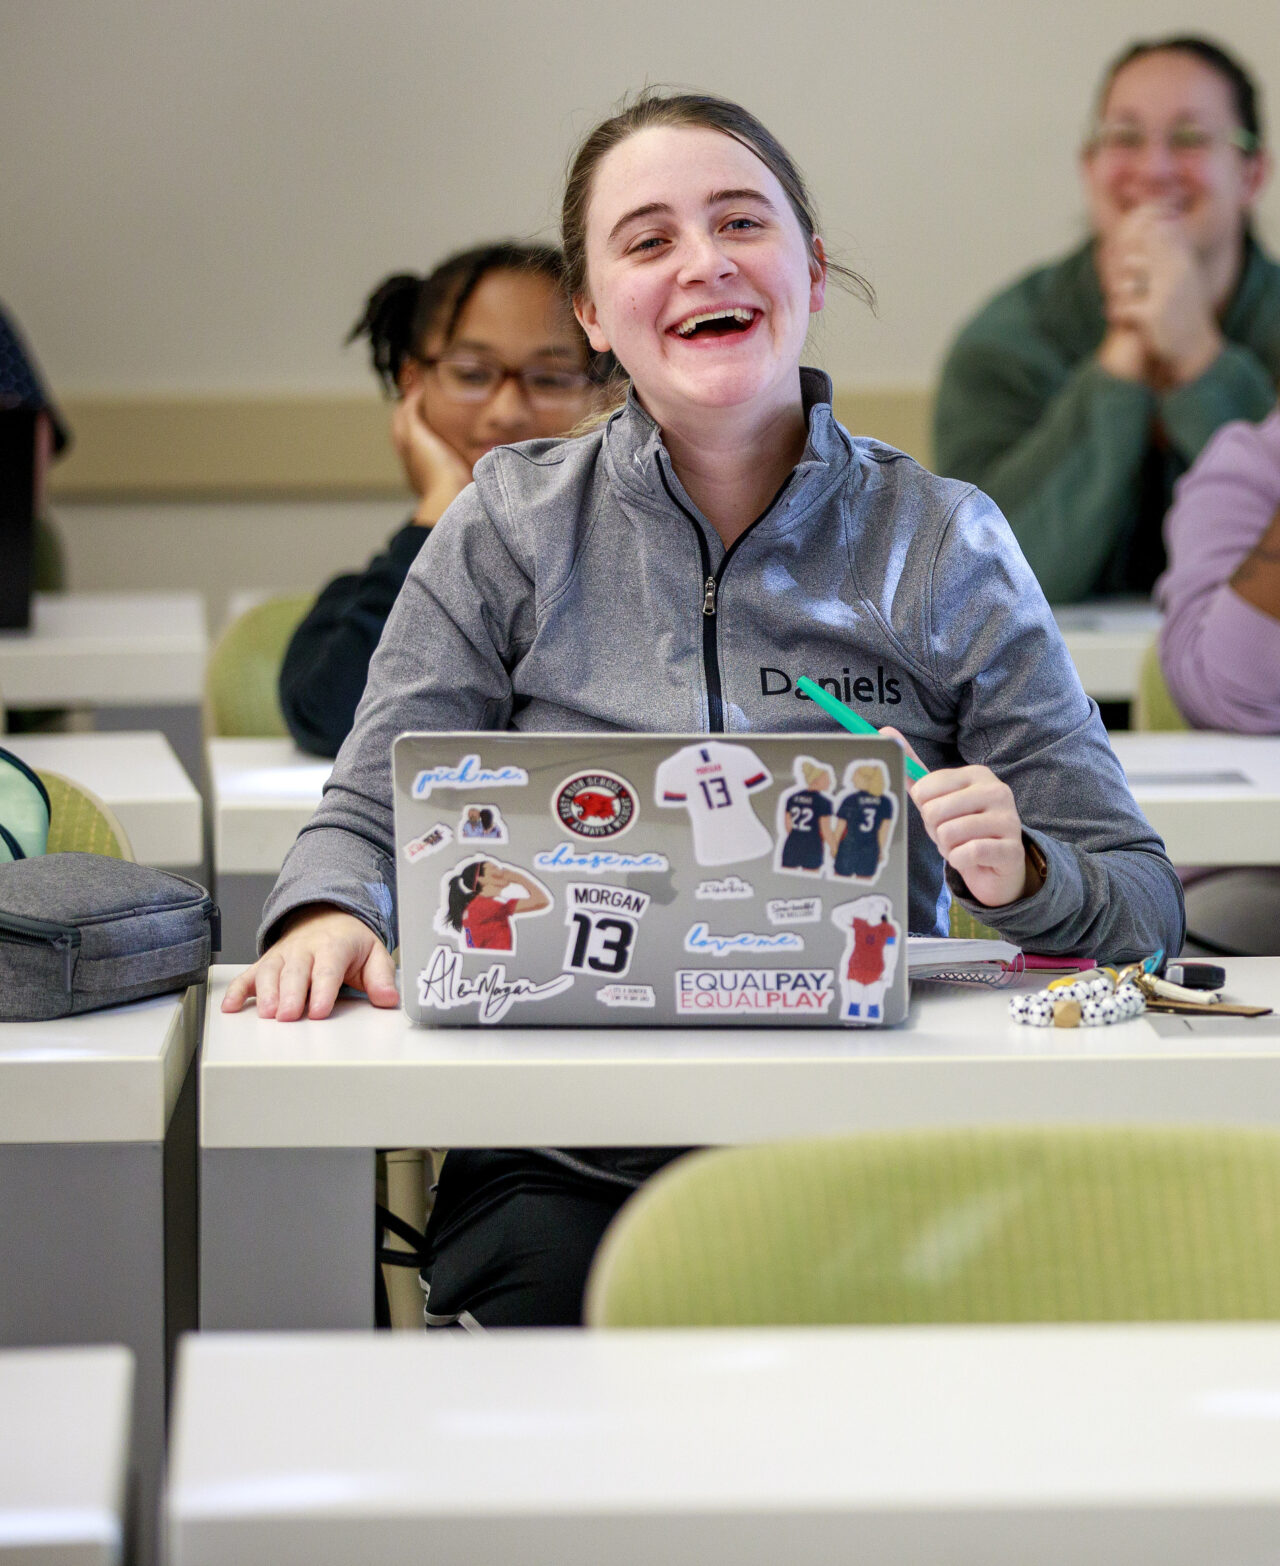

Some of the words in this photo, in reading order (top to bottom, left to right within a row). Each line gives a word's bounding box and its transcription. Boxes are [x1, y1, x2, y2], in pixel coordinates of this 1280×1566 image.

[417, 759, 480, 793] pick
[563, 778, 586, 797] HIGH
[587, 777, 624, 793] SCHOOL
[699, 776, 732, 809] 13
[560, 796, 573, 818] EAST
[570, 822, 606, 835] ALWAYS
[611, 797, 631, 829] WILDCAT
[791, 806, 814, 832] 22
[860, 807, 877, 832] 3
[538, 846, 620, 869] choose
[574, 887, 646, 913] MORGAN
[571, 912, 634, 974] 13
[689, 926, 757, 951] love
